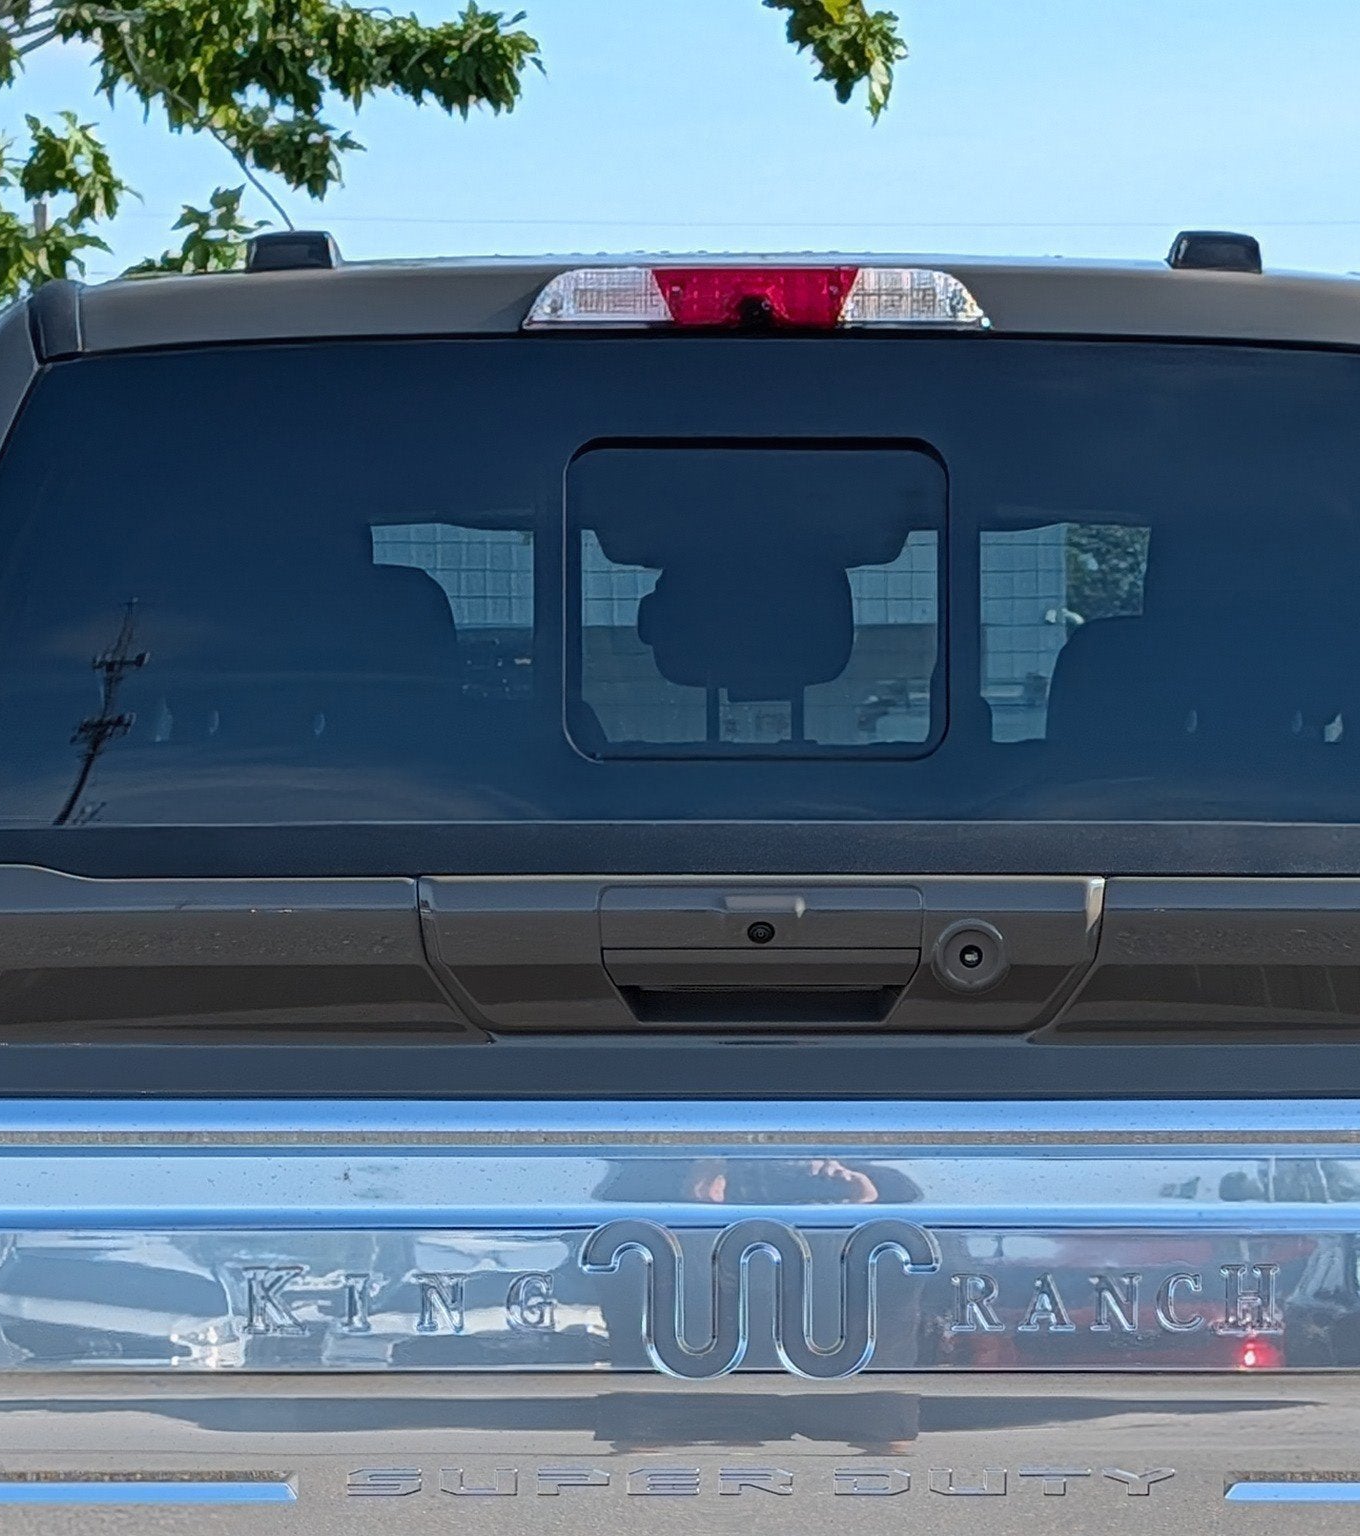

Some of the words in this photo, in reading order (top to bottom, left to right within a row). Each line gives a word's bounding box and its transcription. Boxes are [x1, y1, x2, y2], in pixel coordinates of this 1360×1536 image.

[241, 1264, 560, 1336] KING
[950, 1262, 1286, 1337] RANCH
[346, 1467, 795, 1497] SUPER
[833, 1467, 1176, 1497] DUTY
